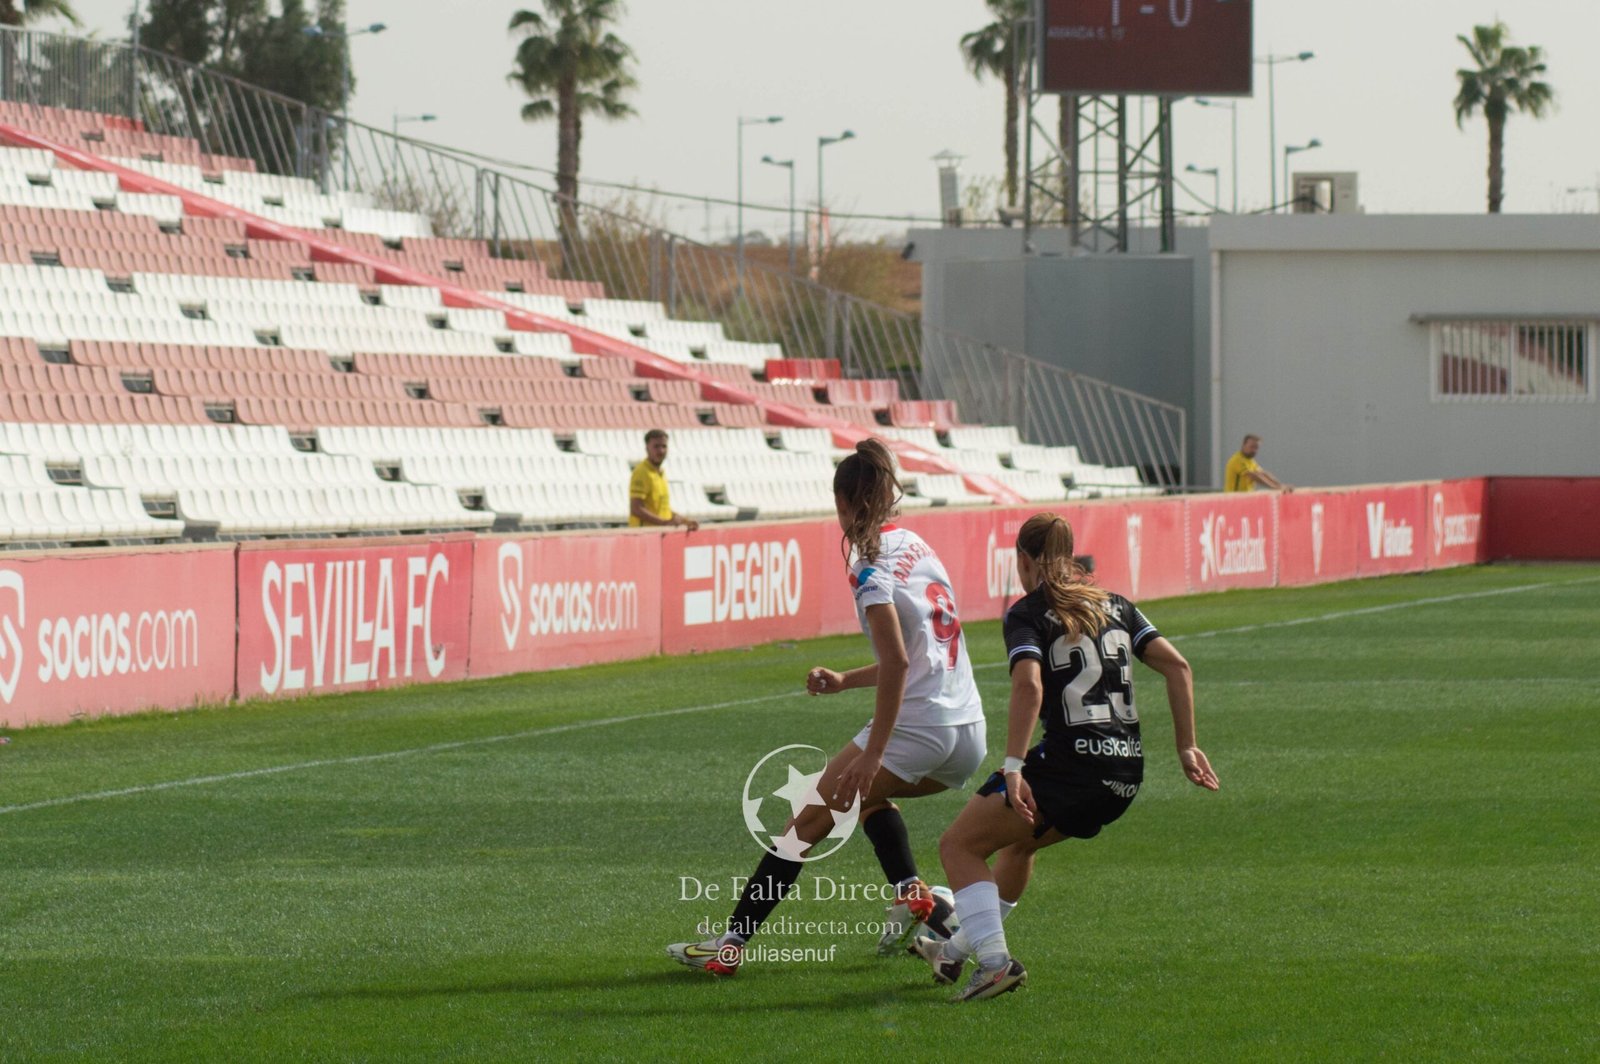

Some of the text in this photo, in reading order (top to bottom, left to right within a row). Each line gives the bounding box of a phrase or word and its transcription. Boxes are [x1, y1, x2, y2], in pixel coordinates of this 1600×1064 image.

[528, 580, 638, 637] socios.com
[712, 537, 803, 623] DEGIRO
[37, 607, 199, 684] socios.com
[260, 552, 449, 695] SEVILLA FC
[925, 581, 961, 672] 9
[1048, 628, 1141, 727] 23
[1074, 735, 1143, 758] euskalte
